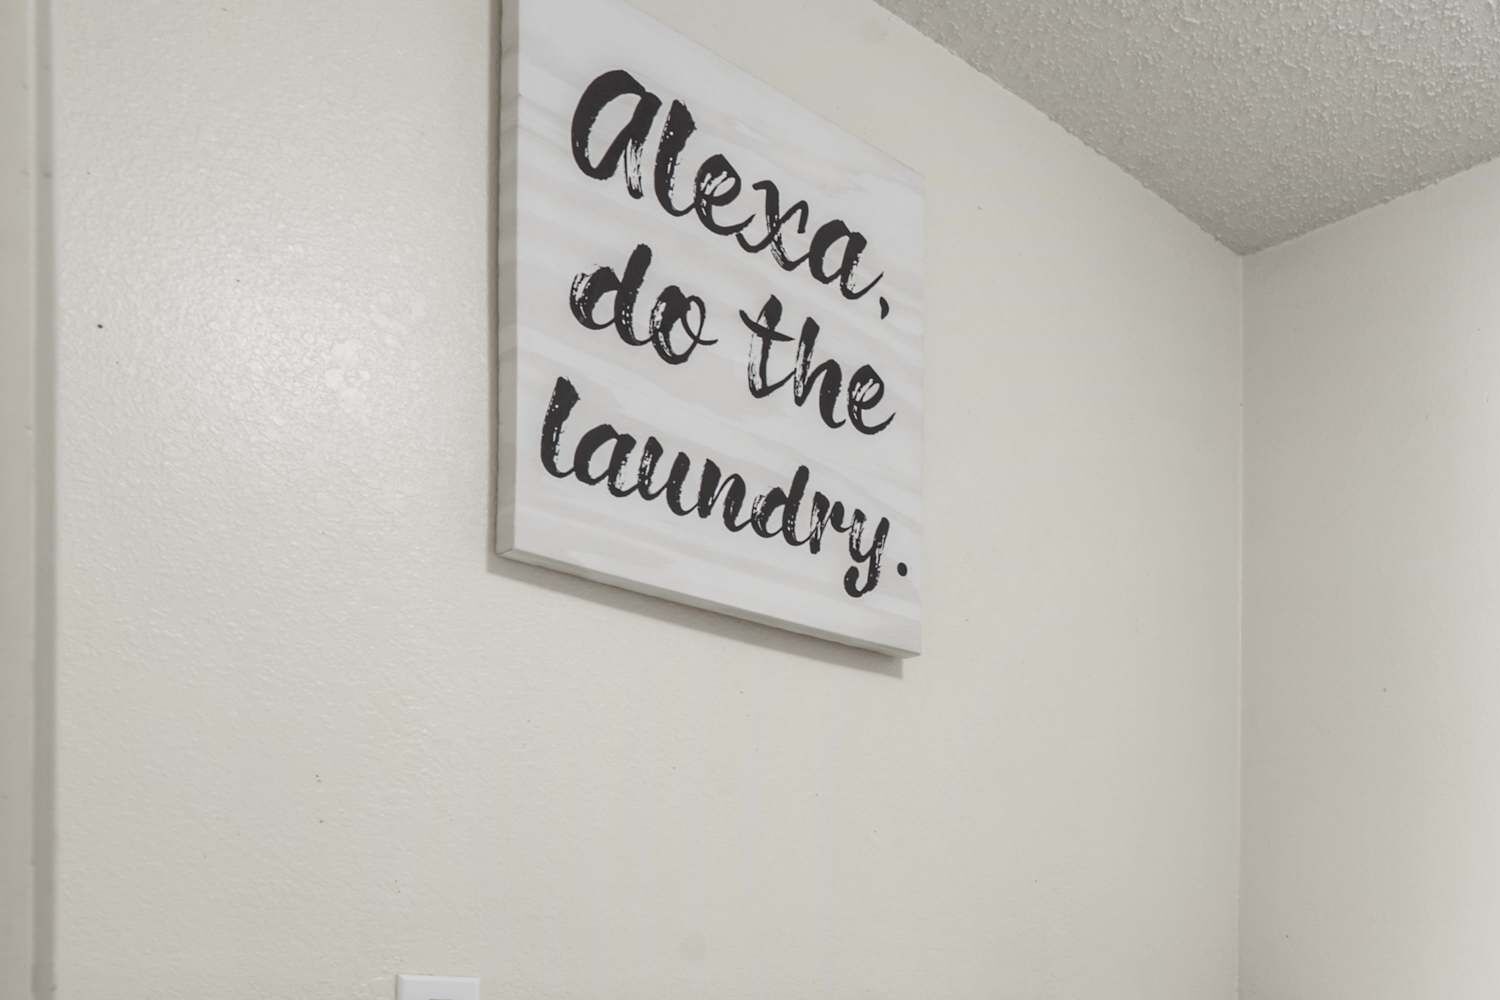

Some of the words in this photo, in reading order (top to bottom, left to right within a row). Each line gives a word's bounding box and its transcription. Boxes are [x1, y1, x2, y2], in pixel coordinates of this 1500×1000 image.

[569, 243, 718, 365] do
[739, 294, 896, 435] the
[540, 376, 908, 598] laundry.
